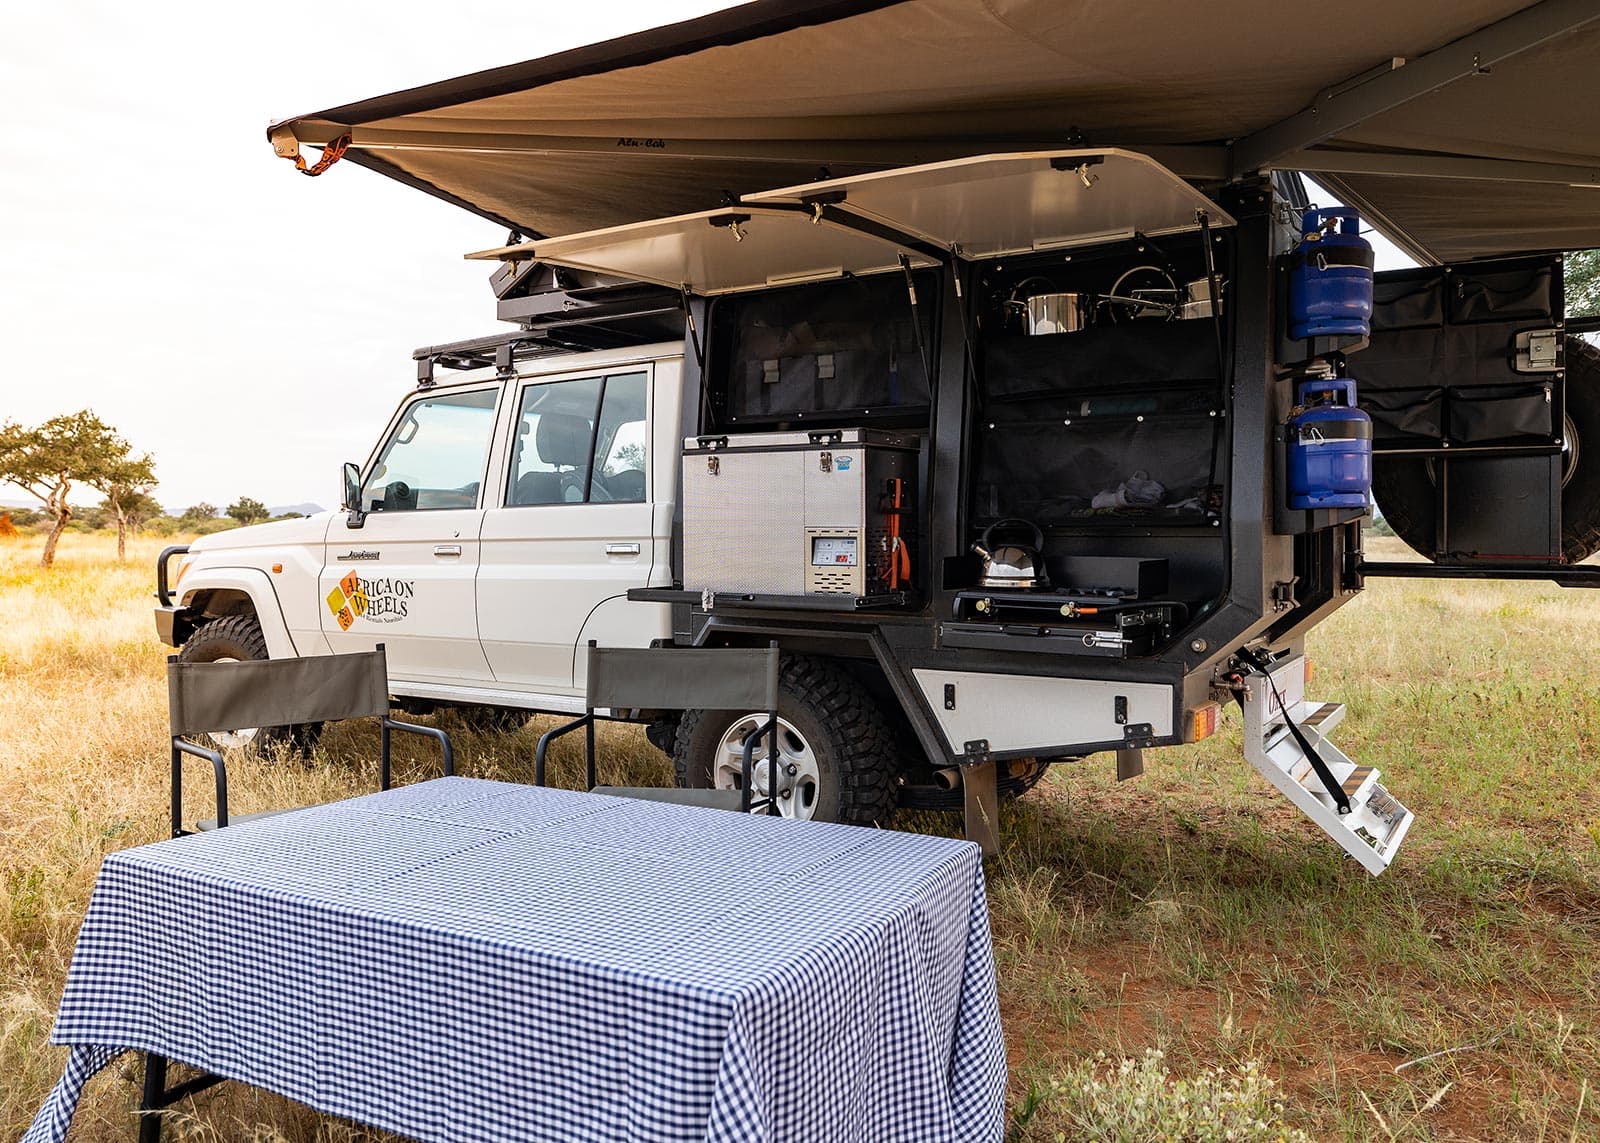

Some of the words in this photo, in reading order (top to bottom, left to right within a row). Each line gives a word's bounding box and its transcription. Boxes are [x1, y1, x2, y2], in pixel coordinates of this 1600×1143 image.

[347, 577, 392, 597] AFRICA
[394, 579, 415, 598] ON
[353, 595, 408, 617] WHEELS
